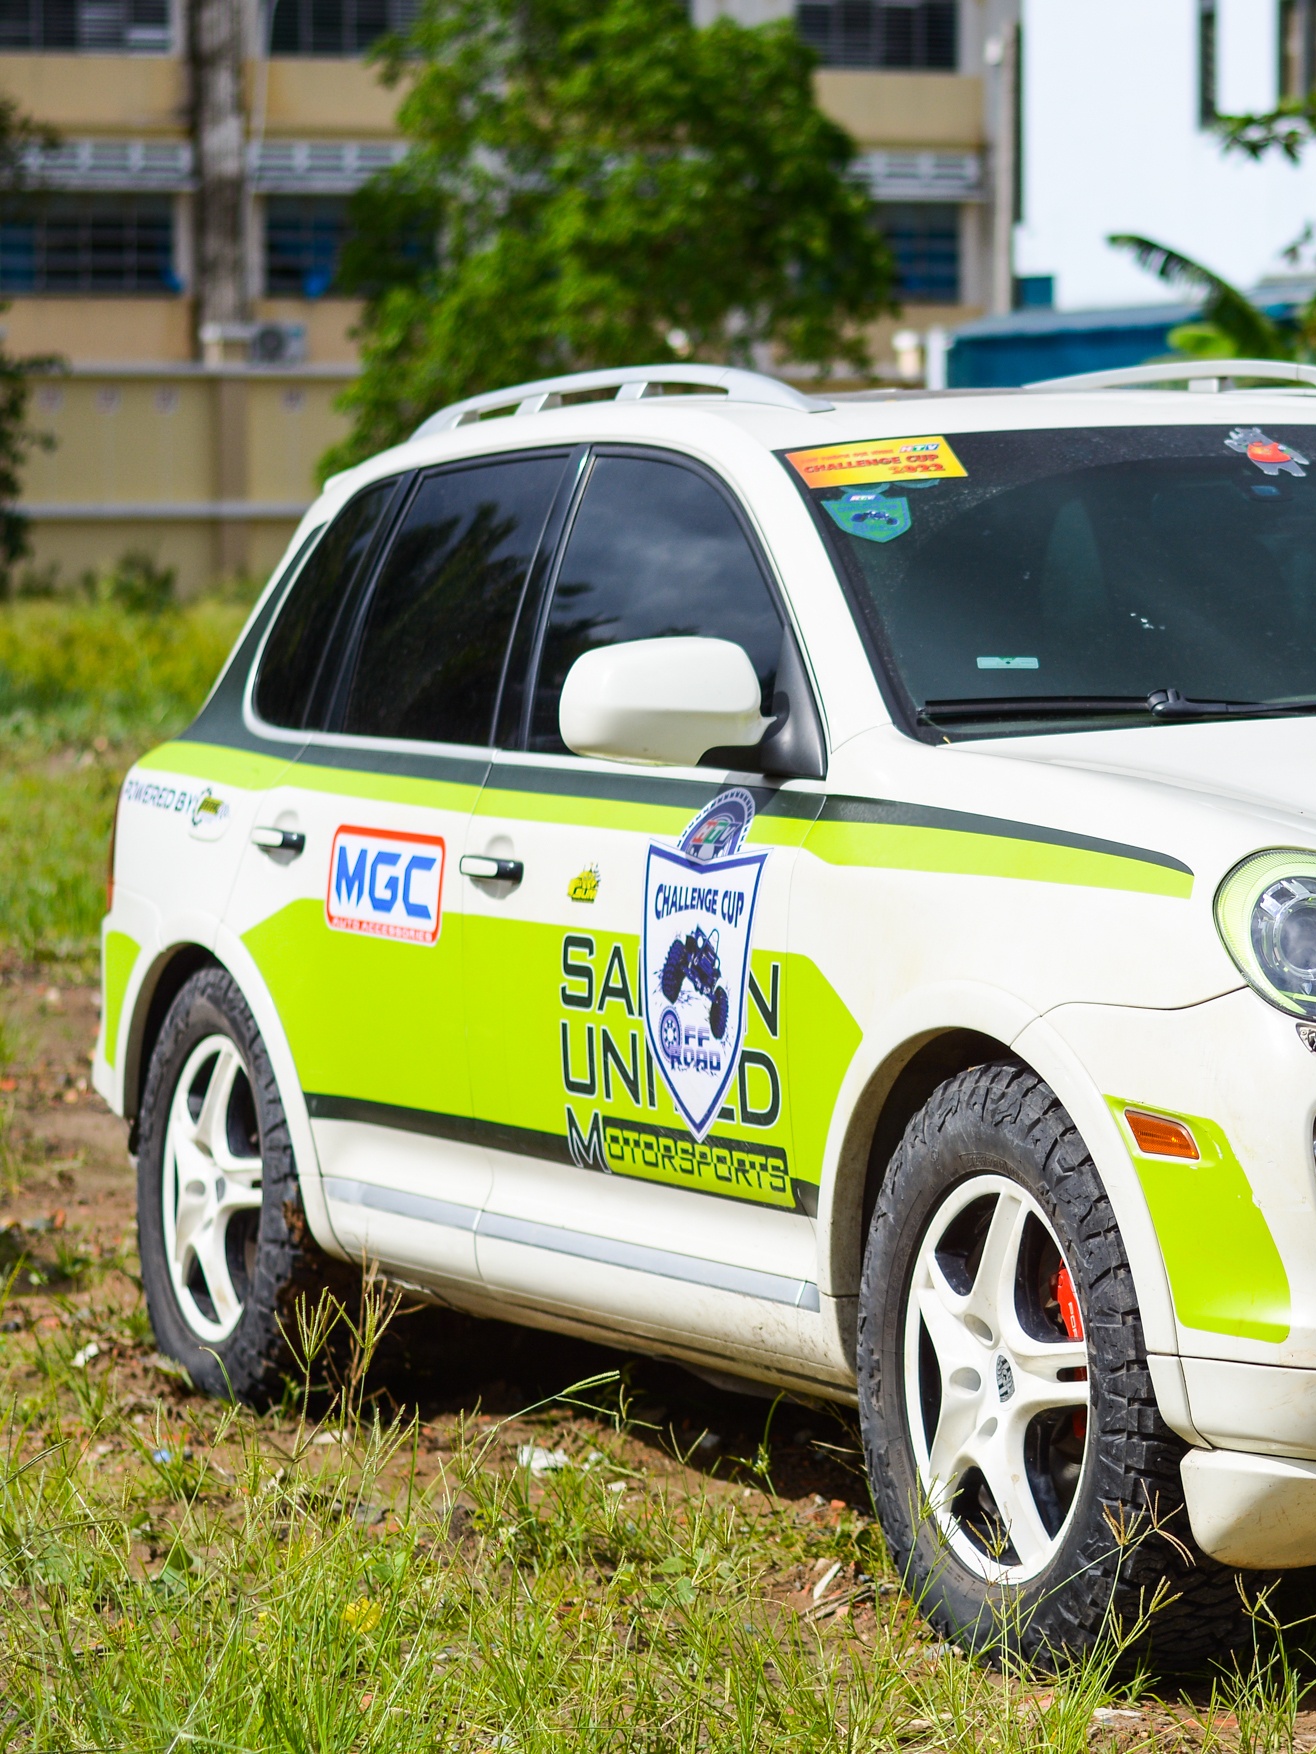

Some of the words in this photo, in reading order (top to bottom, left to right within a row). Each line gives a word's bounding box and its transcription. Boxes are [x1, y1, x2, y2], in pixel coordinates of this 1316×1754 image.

[899, 443, 940, 454] HTV
[803, 456, 902, 474] CHALLENGE
[905, 454, 939, 464] CUP
[691, 820, 742, 846] HTV
[335, 845, 437, 920] MGC
[654, 883, 719, 920] CHALLENGE
[721, 890, 745, 928] CUP
[670, 1047, 721, 1072] ROAD
[561, 1022, 780, 1127] UNID
